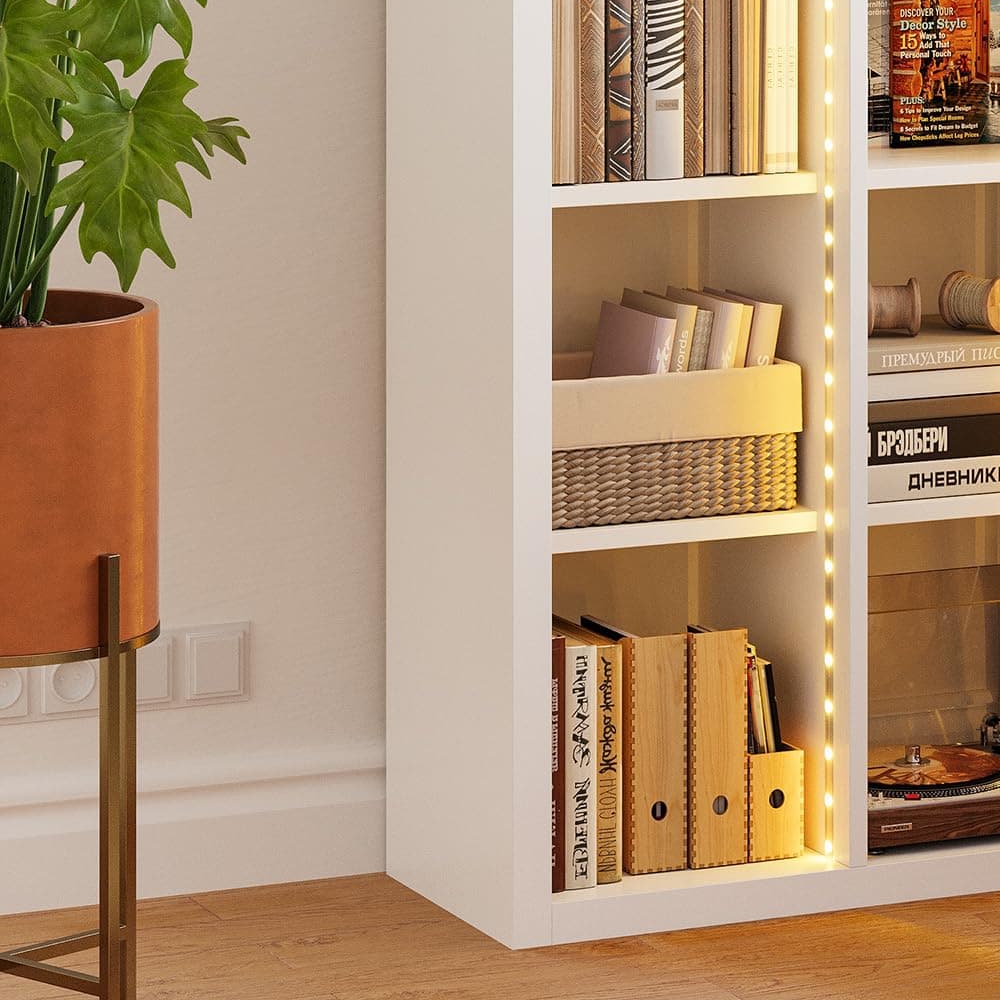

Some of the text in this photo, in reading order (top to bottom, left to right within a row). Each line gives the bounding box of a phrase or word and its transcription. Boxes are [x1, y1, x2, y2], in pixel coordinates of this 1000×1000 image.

[900, 8, 934, 18] DISCOVER
[935, 7, 954, 17] YOUR
[900, 18, 967, 32] Decor Style
[900, 33, 918, 50] 15
[938, 31, 946, 40] to
[919, 40, 950, 49] Add That
[900, 50, 952, 59] Personal Touch
[900, 96, 925, 105] PLUS:
[881, 347, 966, 368] ПРЕМУДРЫЙ
[877, 425, 948, 457] БРЭДБЕРИ
